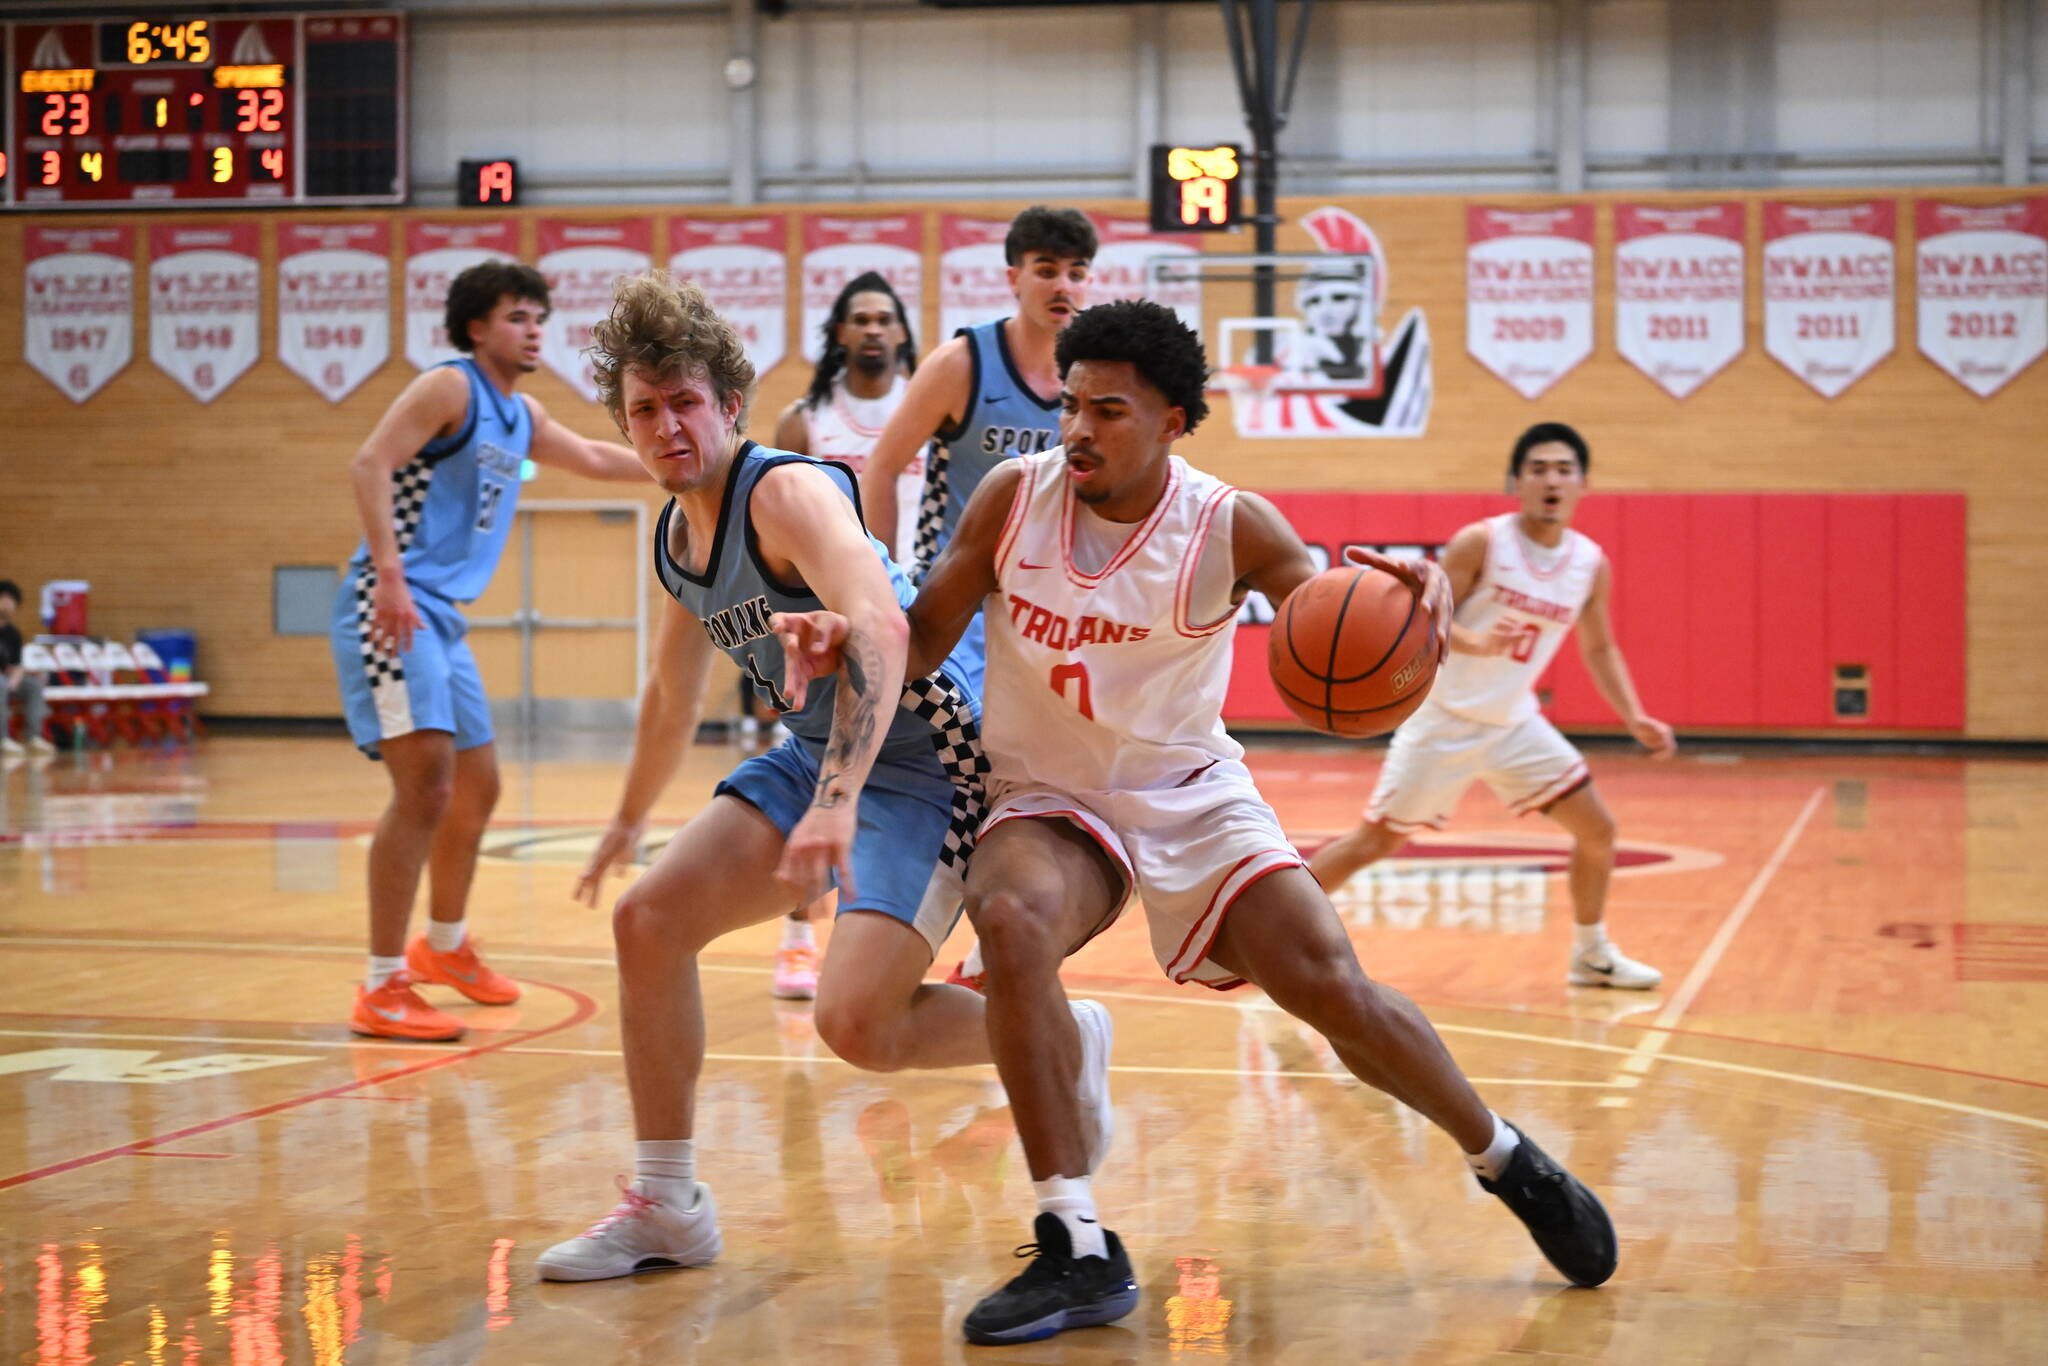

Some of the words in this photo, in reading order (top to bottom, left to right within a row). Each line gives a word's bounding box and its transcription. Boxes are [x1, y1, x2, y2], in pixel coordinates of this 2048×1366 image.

[128, 21, 210, 64] 6:45
[42, 94, 90, 135] 23
[156, 98, 167, 127] 1
[238, 90, 284, 132] 32
[43, 151, 60, 185] 3
[81, 152, 102, 182] 4
[213, 147, 233, 182] 3
[261, 149, 283, 178] 4
[1471, 258, 1588, 280] NWAACC
[1618, 257, 1741, 279] NWAACC
[1767, 256, 1889, 278] NWAACC
[1917, 254, 2043, 276] NWAACC
[1493, 316, 1565, 341] 2009
[1647, 315, 1708, 340] 2011
[1797, 314, 1859, 338] 2011
[1947, 312, 2016, 338] 2012
[1008, 593, 1152, 651] TROJANS
[1392, 655, 1424, 692] PRO
[1050, 661, 1094, 722] 0
